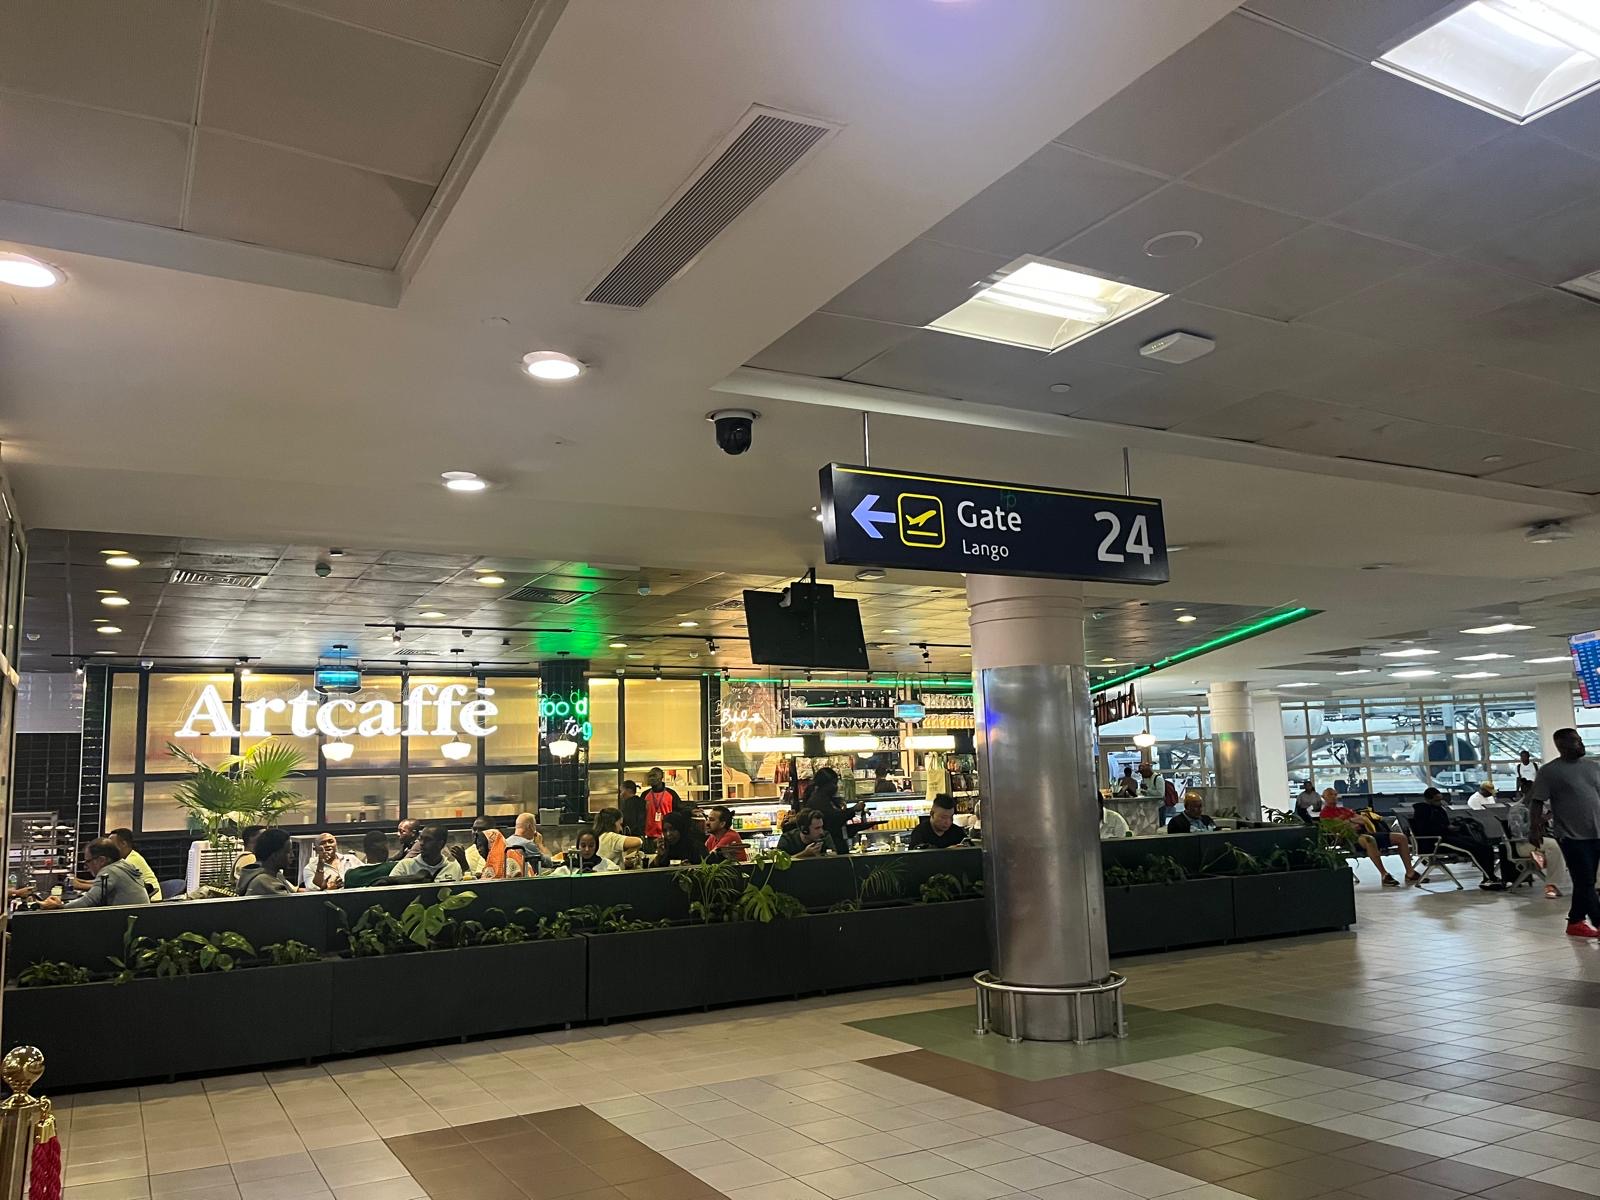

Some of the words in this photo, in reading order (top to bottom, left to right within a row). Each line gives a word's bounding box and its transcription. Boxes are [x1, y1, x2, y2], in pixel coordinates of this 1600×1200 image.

[957, 500, 1022, 532] Gate
[1094, 510, 1154, 565] 24
[962, 538, 1009, 562] Lango
